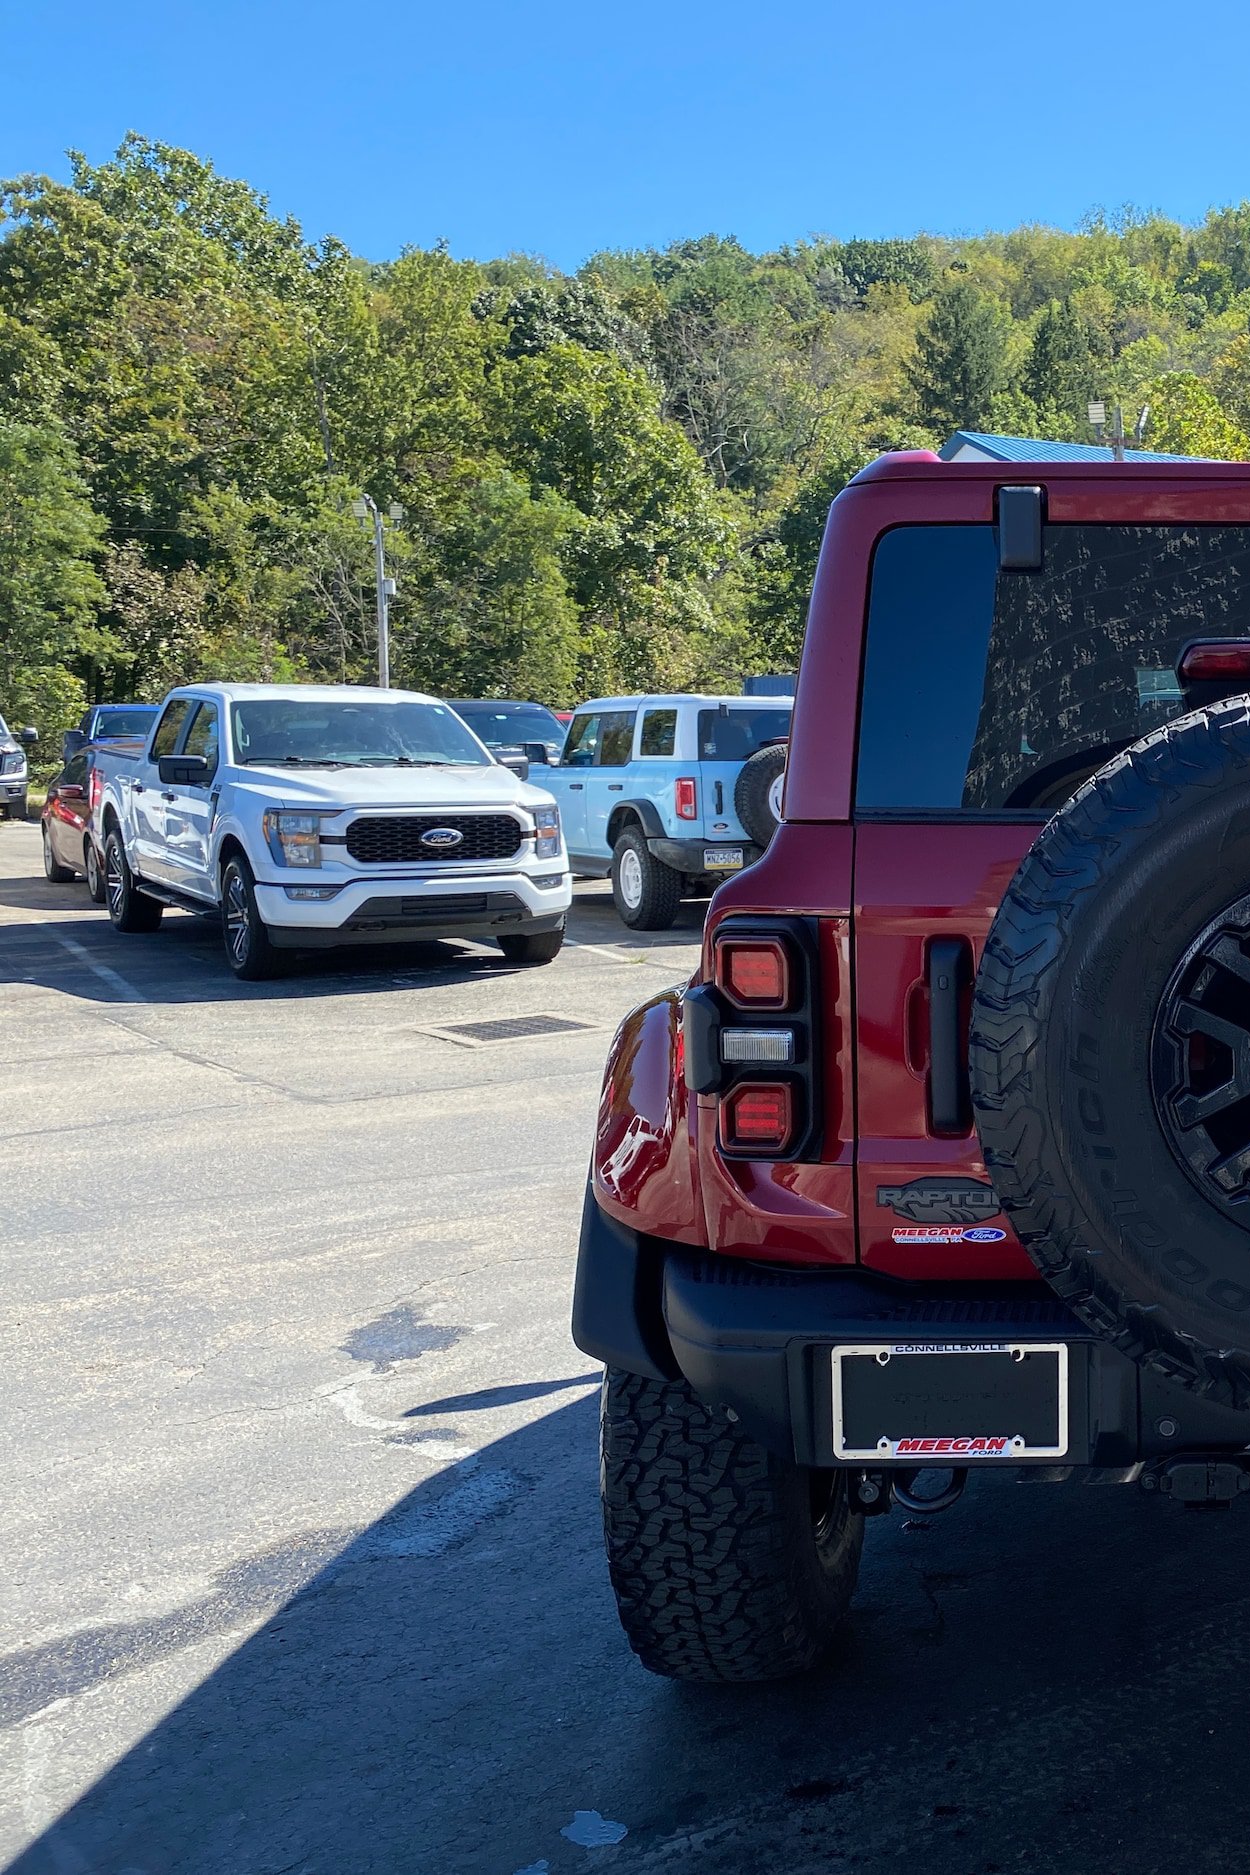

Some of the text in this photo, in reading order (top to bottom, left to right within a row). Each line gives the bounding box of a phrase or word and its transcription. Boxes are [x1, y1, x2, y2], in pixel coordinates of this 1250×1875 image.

[893, 1228, 963, 1236] MEEGAN
[895, 1344, 1006, 1353] CONNELLSVILLE
[896, 1438, 1008, 1451] MEEGAN
